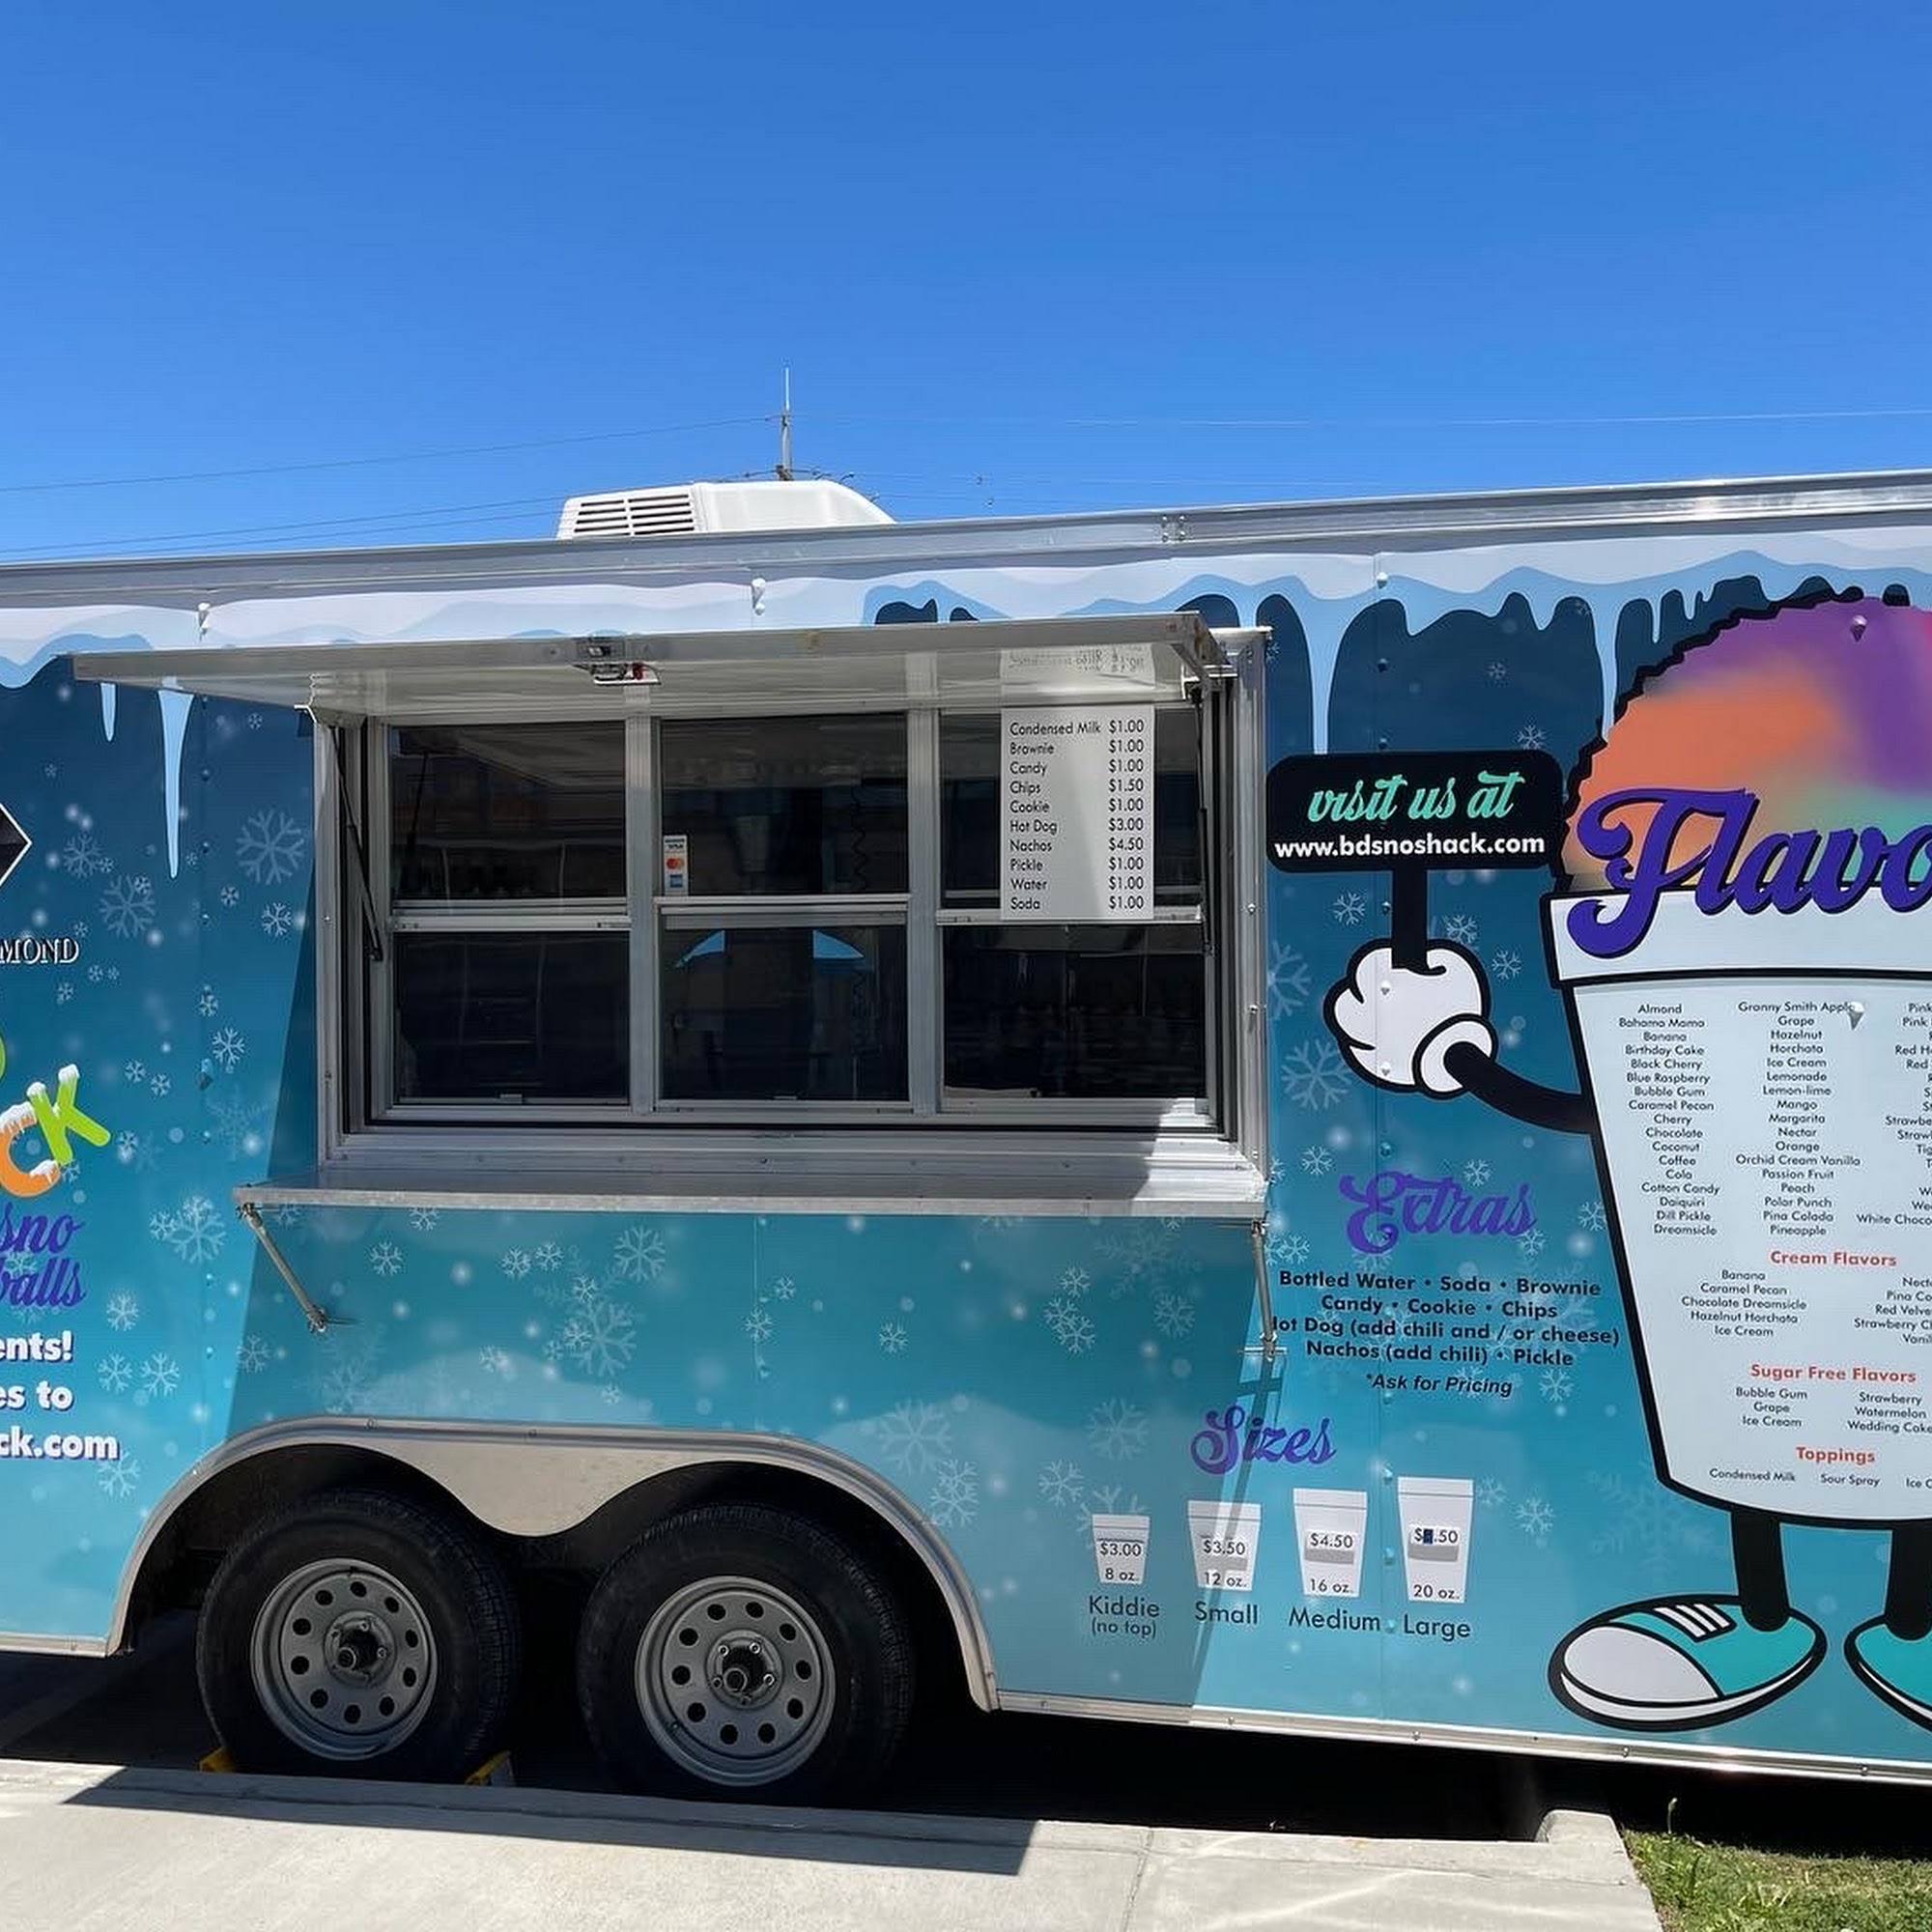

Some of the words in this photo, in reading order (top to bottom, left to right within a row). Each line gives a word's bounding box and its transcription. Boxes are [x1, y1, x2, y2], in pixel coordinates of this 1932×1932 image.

[1010, 723, 1072, 735] Condensed
[1077, 722, 1100, 733] Milk
[1109, 720, 1144, 734] $1.00
[1010, 742, 1054, 754] Brownie
[1109, 739, 1144, 753] $1.00
[1010, 761, 1046, 777] Candy
[1109, 758, 1144, 773] $1.00
[1009, 781, 1040, 796] Chips
[1109, 779, 1144, 792] $1.50
[1307, 774, 1408, 822] visit
[1407, 777, 1457, 820] us
[1466, 770, 1525, 819] at
[1010, 800, 1049, 812] Cookie
[1109, 798, 1143, 811] $1.00
[1010, 820, 1029, 832] Hot
[1034, 819, 1057, 836] Dog
[1109, 817, 1143, 831] $3.00
[1010, 839, 1052, 851] Nachos
[1109, 838, 1143, 851] $4.50
[1273, 832, 1546, 858] www.bdsnoshack.com
[1010, 859, 1042, 871] Pickle
[1109, 857, 1144, 870] $1.00
[1010, 878, 1047, 890] Water
[1109, 876, 1144, 890] $1.00
[1011, 897, 1039, 909] Soda
[1109, 895, 1144, 909] $1.00
[1638, 1004, 1682, 1013] Almond
[1738, 1002, 1781, 1013] Granny
[1785, 1002, 1817, 1011] Smith
[1619, 1017, 1665, 1028] Bahama
[1777, 1015, 1814, 1027] Grape
[1643, 1032, 1687, 1041] Banana
[1771, 1030, 1822, 1039] Hazelnut
[1626, 1044, 1671, 1057] Birthday
[1675, 1045, 1704, 1055] Cake
[1771, 1043, 1823, 1053] Horchata
[1631, 1059, 1661, 1068] Black
[1663, 1059, 1702, 1070] Cherry
[1767, 1058, 1783, 1067] Ice
[1787, 1057, 1827, 1067] Cream
[1627, 1072, 1651, 1082] Blue
[1655, 1072, 1710, 1085] Raspberry
[1767, 1071, 1827, 1081] Lemonade
[1634, 1086, 1673, 1096] Bubble
[1677, 1086, 1705, 1096] Gum
[1629, 1100, 1677, 1110] Caramel
[1681, 1100, 1714, 1111] Pecan
[1777, 1100, 1817, 1111] Mango
[1654, 1114, 1692, 1126] Cherry
[1769, 1114, 1825, 1124] Margarita
[1645, 1127, 1703, 1138] Chocolate
[1778, 1127, 1816, 1137] Nectar
[1652, 1141, 1699, 1151] Coconut
[1776, 1141, 1820, 1152] Orange
[1659, 1155, 1695, 1165] Coffee
[1736, 1153, 1775, 1165] Orchid
[1778, 1155, 1817, 1165] Cream
[1820, 1155, 1861, 1166] Vanilla
[1665, 1169, 1692, 1179] Cola
[1763, 1168, 1802, 1179] Passion
[1804, 1169, 1834, 1179] Fruit
[1641, 1182, 1680, 1193] Cotton
[1683, 1182, 1719, 1195] Candy
[1781, 1182, 1814, 1193] Peach
[1660, 1197, 1704, 1208] Daiquiri
[1765, 1196, 1793, 1207] Polar
[1798, 1197, 1832, 1208] Punch
[1338, 1170, 1538, 1255] Extras
[1657, 1210, 1675, 1220] Dill
[1679, 1210, 1711, 1221] Pickle
[1792, 1210, 1833, 1222] Colada
[1654, 1224, 1717, 1236] Dreamsicle
[1771, 1225, 1826, 1236] Pineapple
[1771, 1251, 1827, 1264] Cream
[1834, 1252, 1896, 1265] Flavors
[1722, 1269, 1765, 1280] Banana
[1280, 1270, 1349, 1287] Bottled
[1356, 1273, 1415, 1290] Water
[1440, 1276, 1490, 1292] Soda
[1518, 1278, 1601, 1295] Brownie
[1700, 1283, 1749, 1293] Caramel
[1754, 1284, 1787, 1294] Pecan
[1321, 1295, 1382, 1315] Candy
[1408, 1298, 1475, 1315] Cookie
[1502, 1300, 1557, 1321] Chips
[1682, 1296, 1739, 1307] Chocolate
[1744, 1298, 1806, 1310] Dreamsicle
[1691, 1311, 1741, 1321] Hazelnut
[1746, 1313, 1798, 1323] Horchata
[1305, 1318, 1343, 1337] Dog
[1351, 1319, 1395, 1337] (add
[1404, 1321, 1443, 1337] chili
[1451, 1323, 1490, 1339] and
[1513, 1329, 1535, 1340] or
[1542, 1325, 1619, 1349] cheese)
[1715, 1325, 1731, 1335] Ice
[1735, 1325, 1774, 1336] Cream
[1307, 1340, 1378, 1358] Nachos
[1386, 1345, 1432, 1362] (add
[1439, 1346, 1487, 1365] chili)
[1515, 1349, 1573, 1365] Pickle
[1751, 1364, 1803, 1381] Sugar
[1809, 1367, 1845, 1379] Free
[1853, 1368, 1916, 1382] Flavors
[1414, 1376, 1440, 1390] for
[1445, 1377, 1512, 1397] Pricing
[1736, 1386, 1775, 1398] Bubble
[1779, 1388, 1807, 1399] Gum
[36, 1380, 73, 1410] to
[1860, 1392, 1921, 1406] Strawberry
[1754, 1402, 1790, 1414] Grape
[1855, 1406, 1926, 1418] Watermelon
[1743, 1415, 1759, 1426] Ice
[1763, 1416, 1802, 1427] Cream
[1848, 1420, 1899, 1434] Wedding
[1190, 1404, 1337, 1475] Sizes
[1796, 1447, 1875, 1465] Toppings
[1710, 1468, 1771, 1480] Condensed
[1774, 1472, 1795, 1481] Milk
[1821, 1473, 1845, 1484] Sour
[1849, 1474, 1880, 1487] Spray
[1309, 1531, 1353, 1549] $4.50
[1414, 1527, 1458, 1544] $.50
[1099, 1542, 1142, 1557] $3.00
[1203, 1540, 1246, 1555] $3.50
[1105, 1568, 1114, 1580] 8
[1119, 1570, 1140, 1581] oz.
[1204, 1572, 1221, 1585] 12
[1226, 1577, 1247, 1588] oz.
[1309, 1578, 1327, 1593] 16
[1331, 1580, 1353, 1594] oz.
[1413, 1584, 1433, 1599] 20
[1438, 1589, 1460, 1600] oz.
[1089, 1595, 1160, 1617] Kiddie
[1194, 1601, 1258, 1624] Small
[1289, 1606, 1381, 1633] Medium
[1092, 1618, 1119, 1636] (no
[1124, 1621, 1157, 1638] top)
[1403, 1614, 1471, 1642] Large
